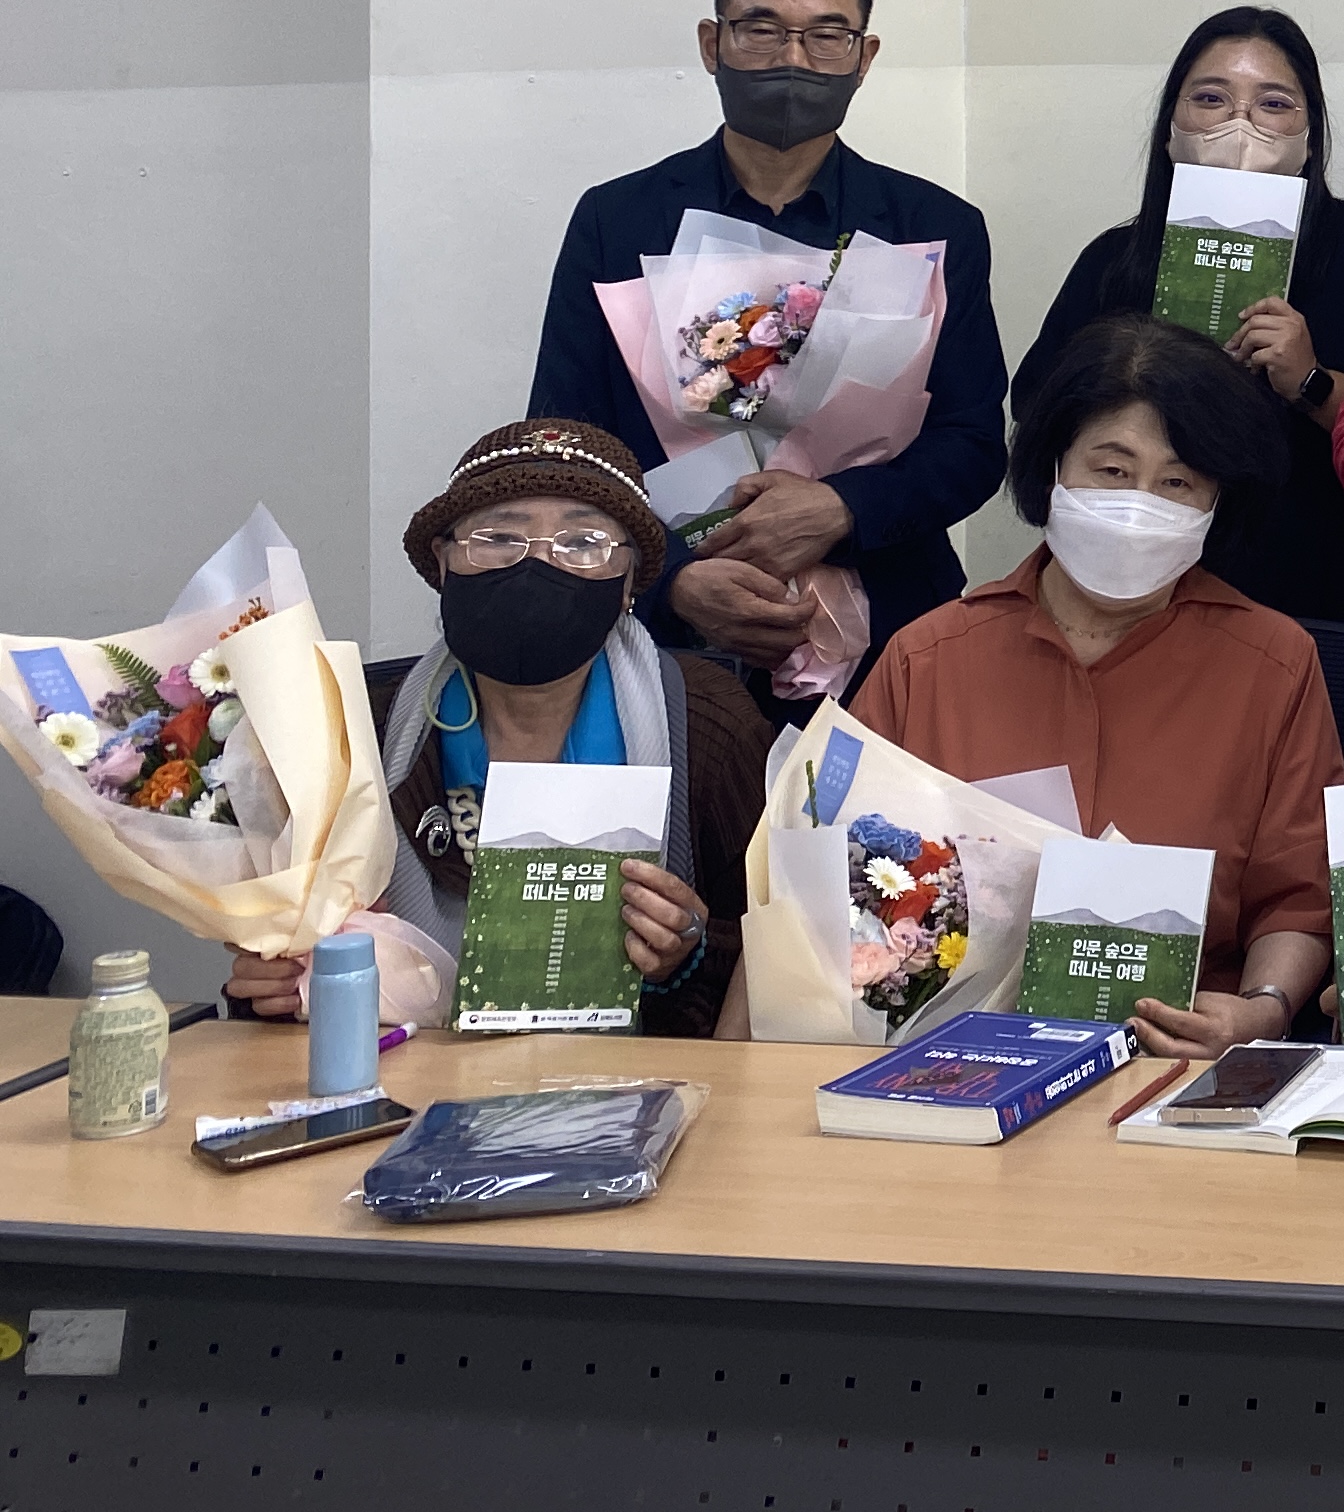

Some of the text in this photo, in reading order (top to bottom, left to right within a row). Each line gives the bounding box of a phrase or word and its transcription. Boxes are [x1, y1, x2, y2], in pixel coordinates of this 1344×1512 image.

[1197, 238, 1255, 257] 인문 숲으로
[1194, 253, 1253, 272] 떠나는 여행
[526, 862, 607, 881] 인문 숲으로
[522, 883, 605, 901] 떠나는 여행
[1072, 938, 1148, 961] 인문 숲으로
[1068, 959, 1146, 983] 떠나는 여행
